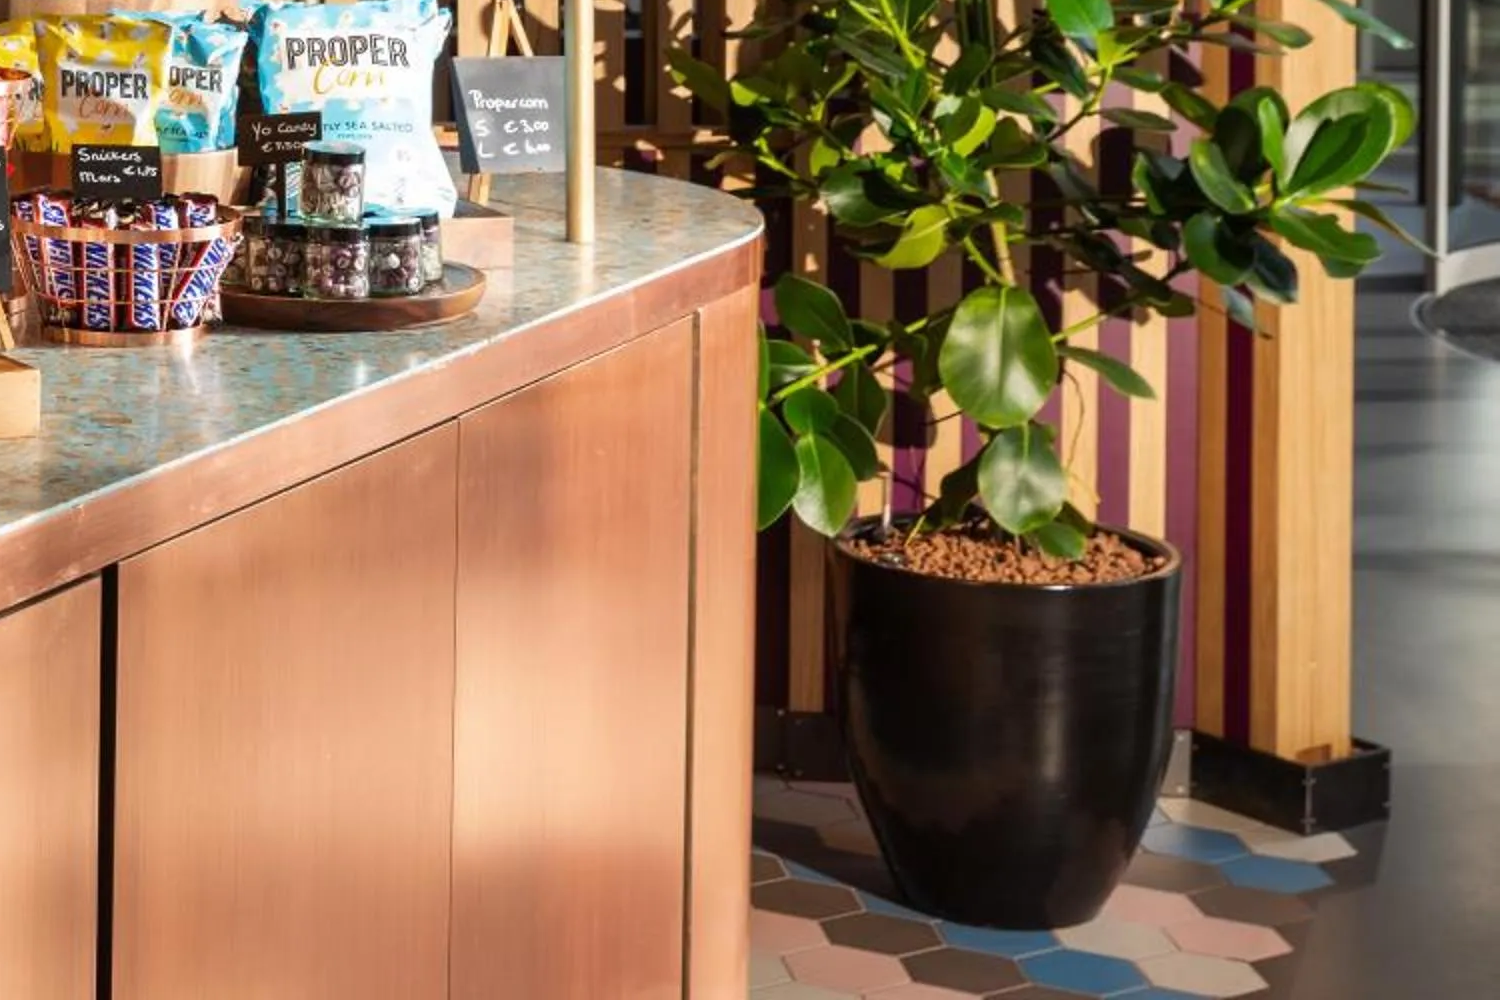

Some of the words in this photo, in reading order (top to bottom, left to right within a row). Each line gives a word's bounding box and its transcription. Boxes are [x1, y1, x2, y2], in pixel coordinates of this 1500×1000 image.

[285, 33, 410, 70] PROPER
[60, 69, 149, 99] PROPER
[168, 65, 223, 94] OPER
